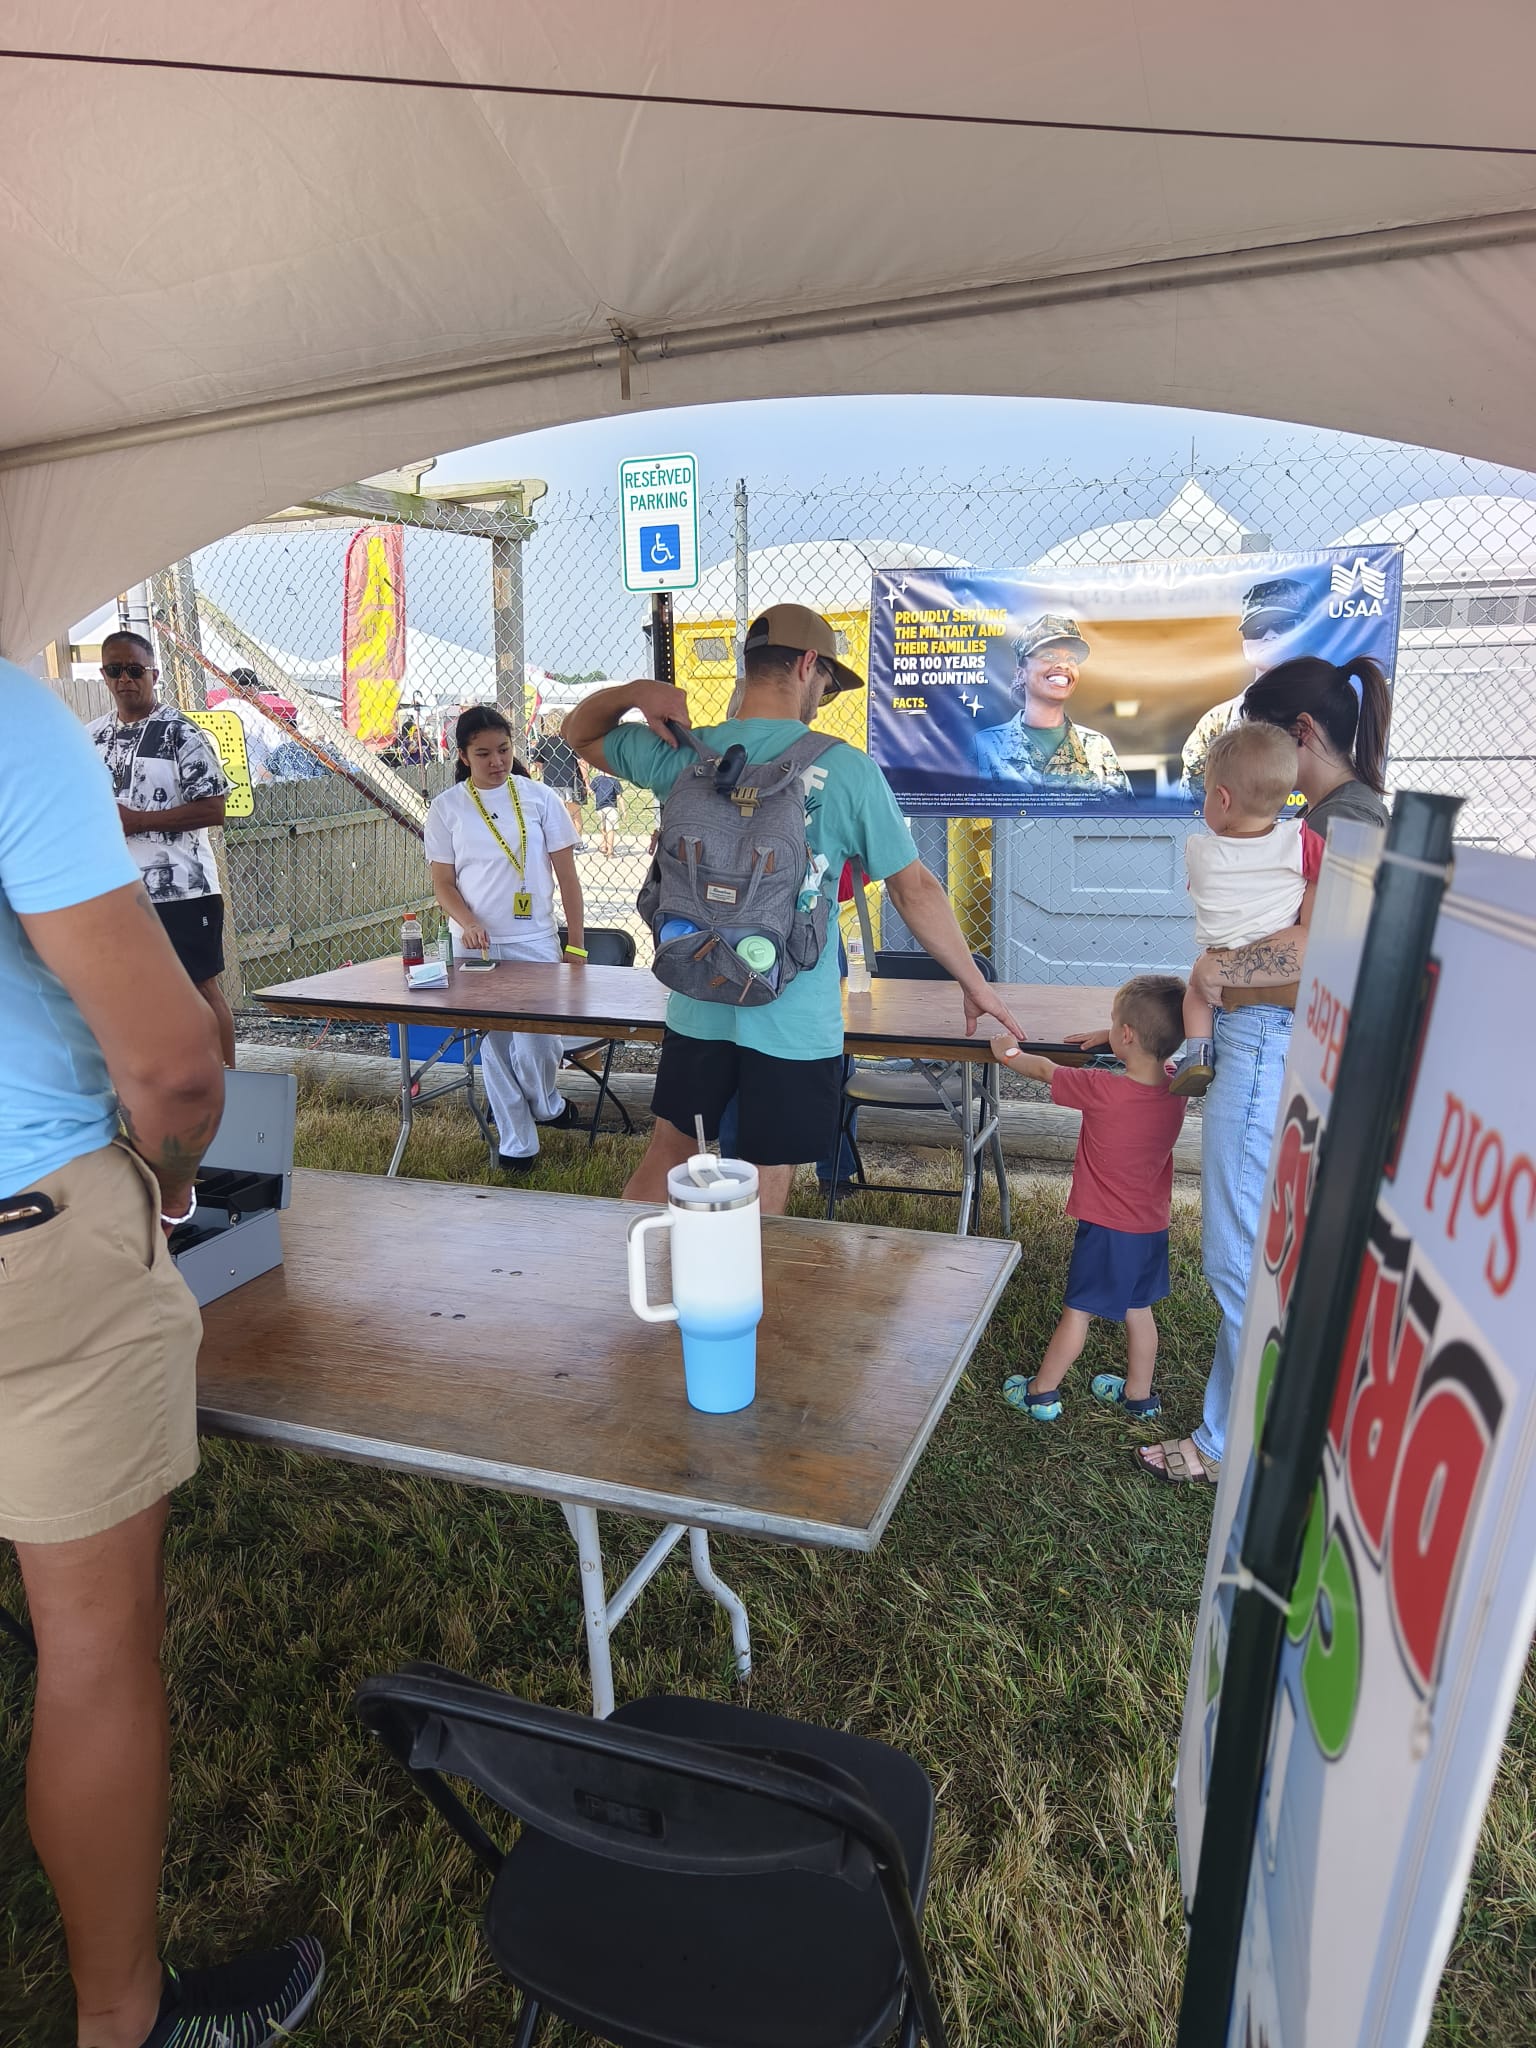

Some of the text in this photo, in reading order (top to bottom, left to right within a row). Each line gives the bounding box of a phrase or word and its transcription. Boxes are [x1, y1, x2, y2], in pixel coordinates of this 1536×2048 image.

[625, 467, 691, 489] RESERVED
[630, 490, 688, 511] PARKING
[895, 608, 1007, 624] PROUDLY SERVING
[1329, 599, 1383, 619] USAA
[895, 624, 1006, 640] THE MILITARY AND
[894, 640, 987, 655] THEIR FAMILIES
[893, 655, 986, 671] FOR 100 YEARS
[893, 670, 989, 686] AND COUNTING.
[893, 697, 928, 709] FACTS.
[1307, 976, 1536, 1298] Sold Here
